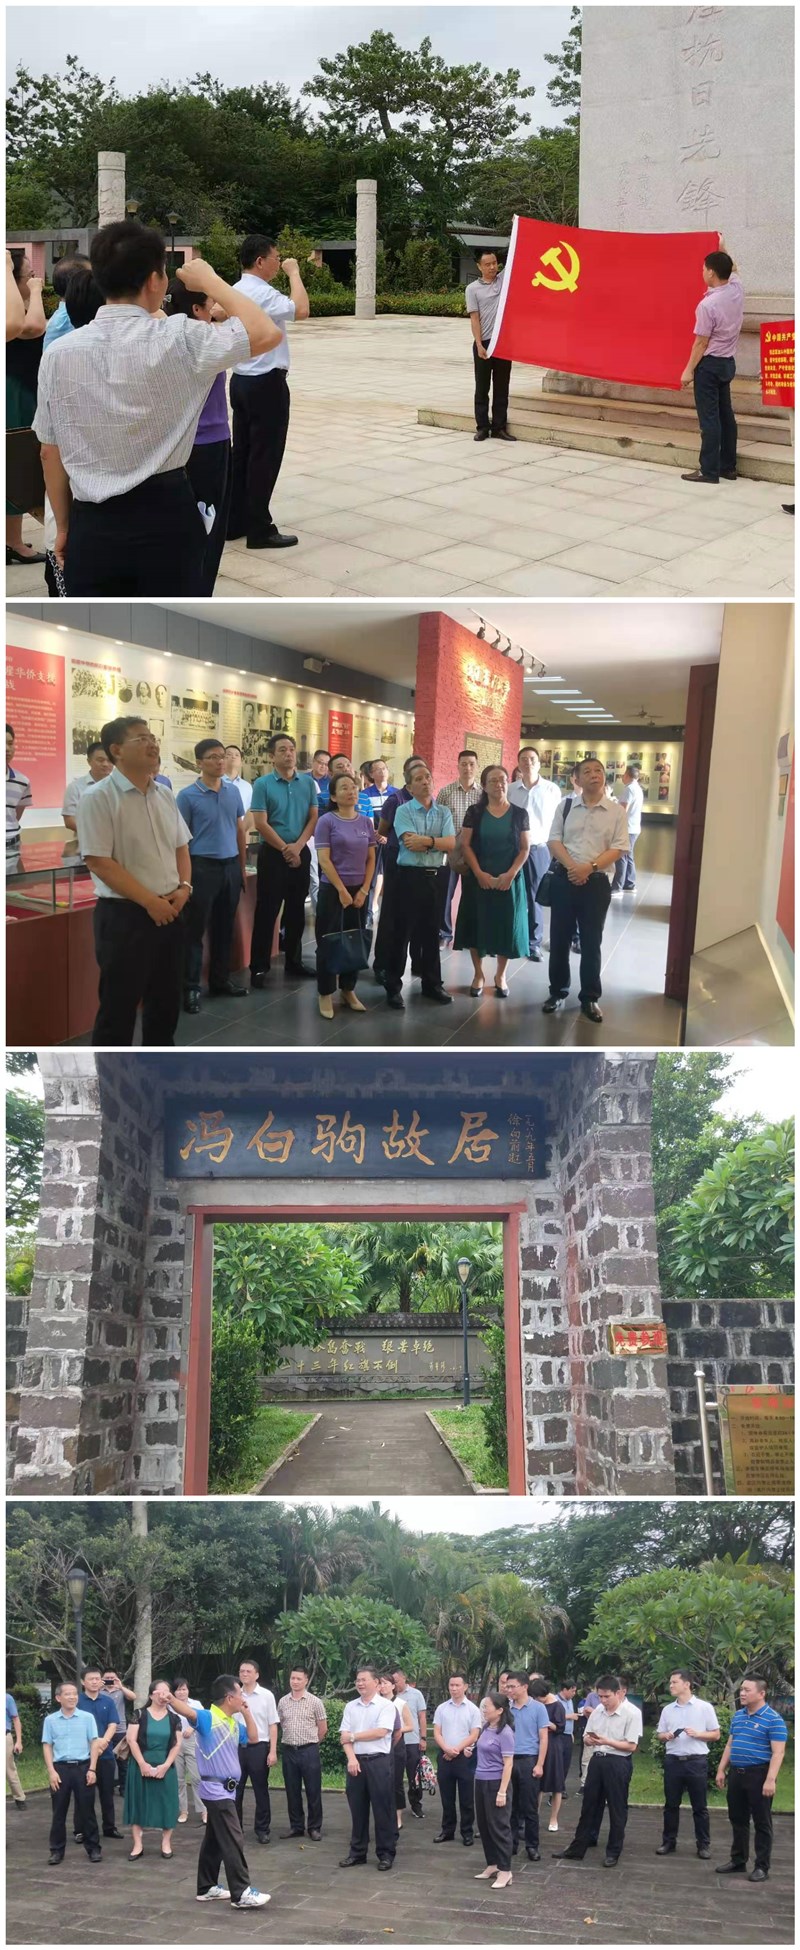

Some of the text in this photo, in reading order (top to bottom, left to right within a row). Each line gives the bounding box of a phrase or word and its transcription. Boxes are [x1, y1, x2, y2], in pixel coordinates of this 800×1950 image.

[179, 1109, 500, 1166] 冯白驹故居
